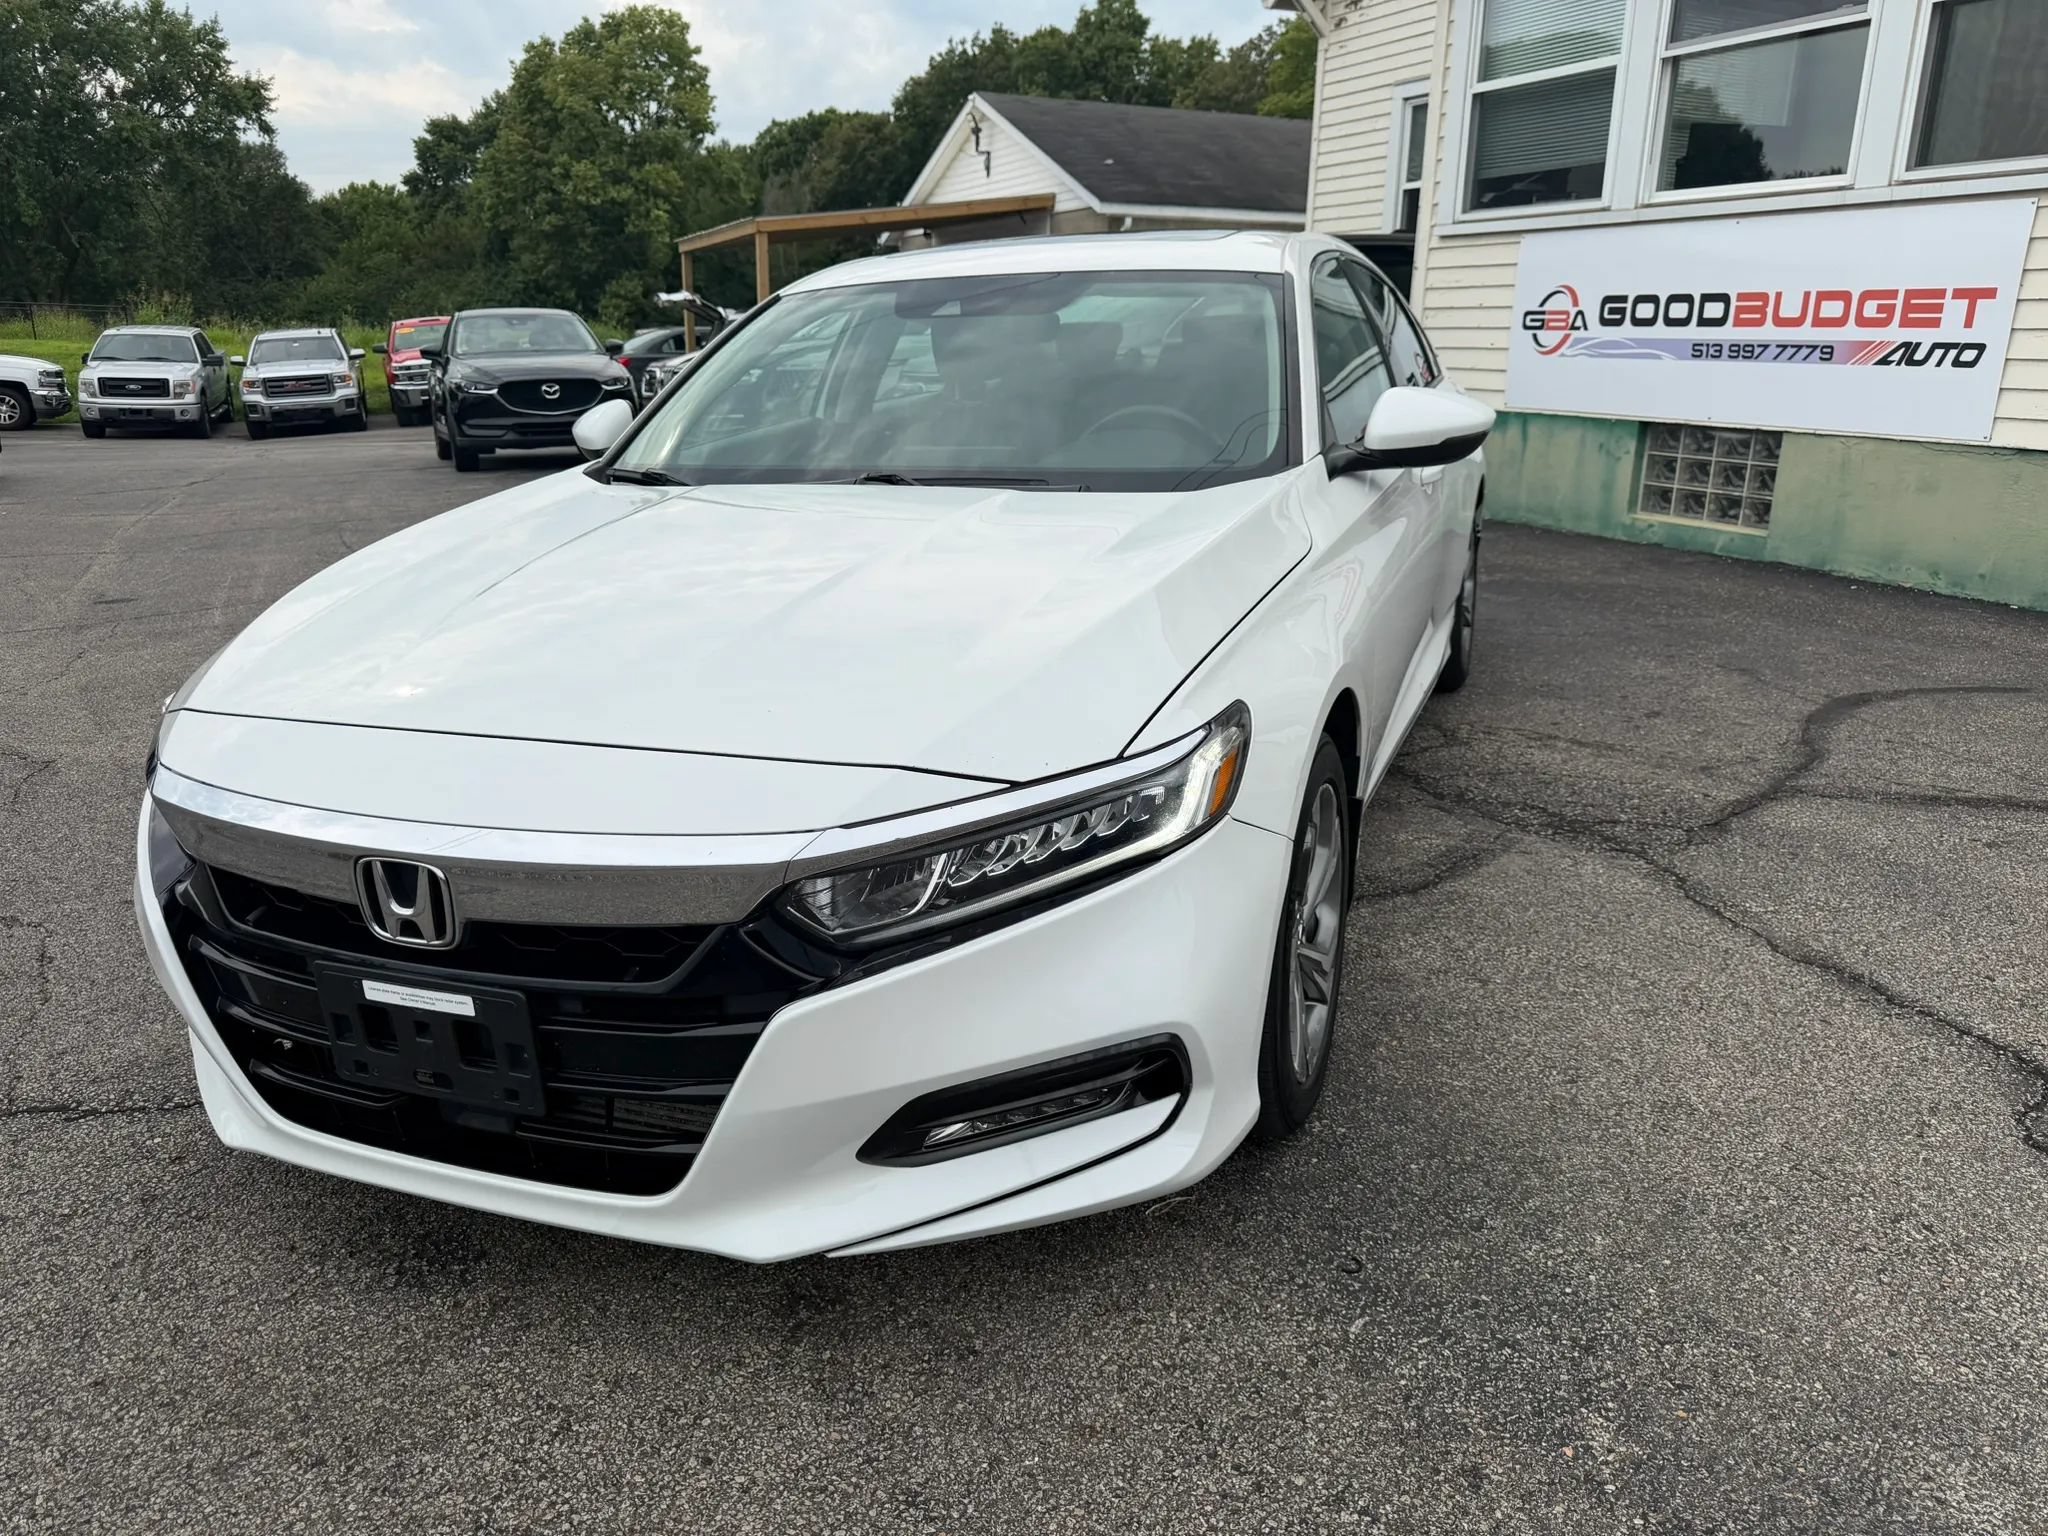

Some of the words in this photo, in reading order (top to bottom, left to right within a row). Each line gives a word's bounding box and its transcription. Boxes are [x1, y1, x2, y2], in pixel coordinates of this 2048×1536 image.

[1522, 309, 1589, 332] GBA
[1691, 343, 1723, 359] 513
[1727, 344, 1770, 360] 997
[1772, 344, 1835, 362] 7779
[1872, 341, 1988, 369] AUTO
